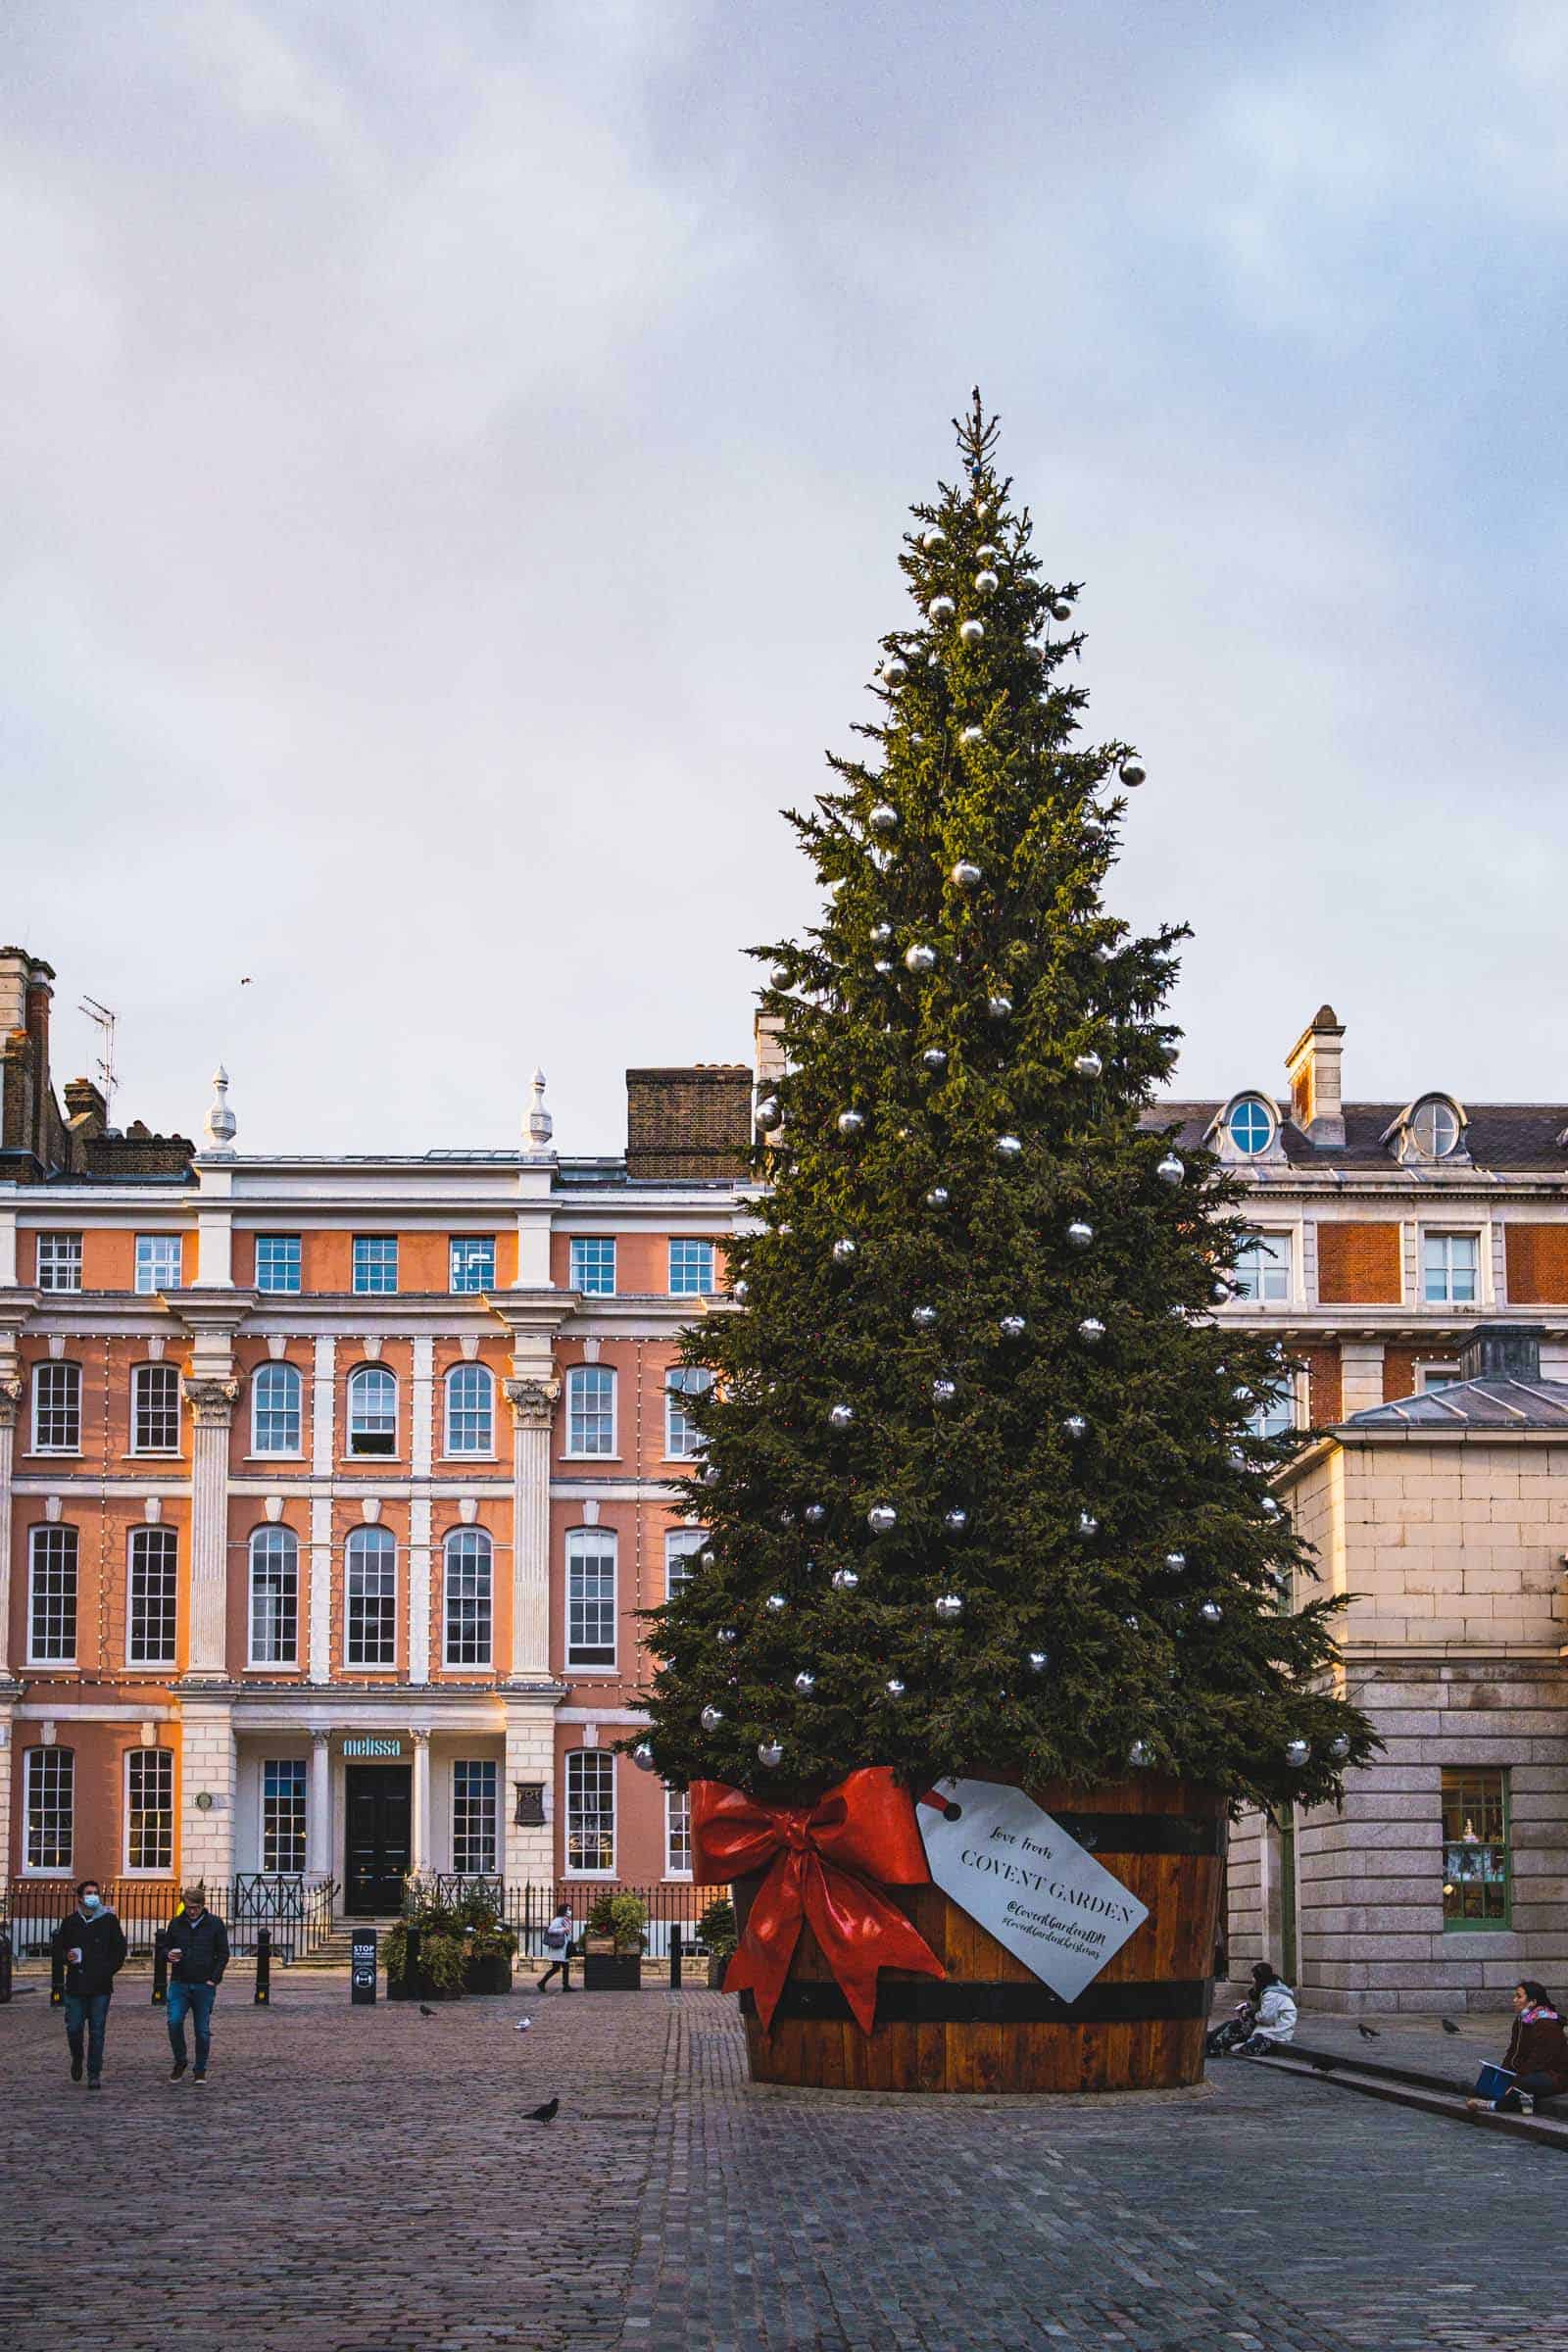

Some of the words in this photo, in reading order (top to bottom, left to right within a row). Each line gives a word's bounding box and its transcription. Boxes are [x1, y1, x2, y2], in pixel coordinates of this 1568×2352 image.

[343, 1737, 400, 1756] melissa
[990, 1826, 1017, 1844] Love
[960, 1849, 1047, 1890] COVENT
[1050, 1882, 1134, 1923] GARDEN
